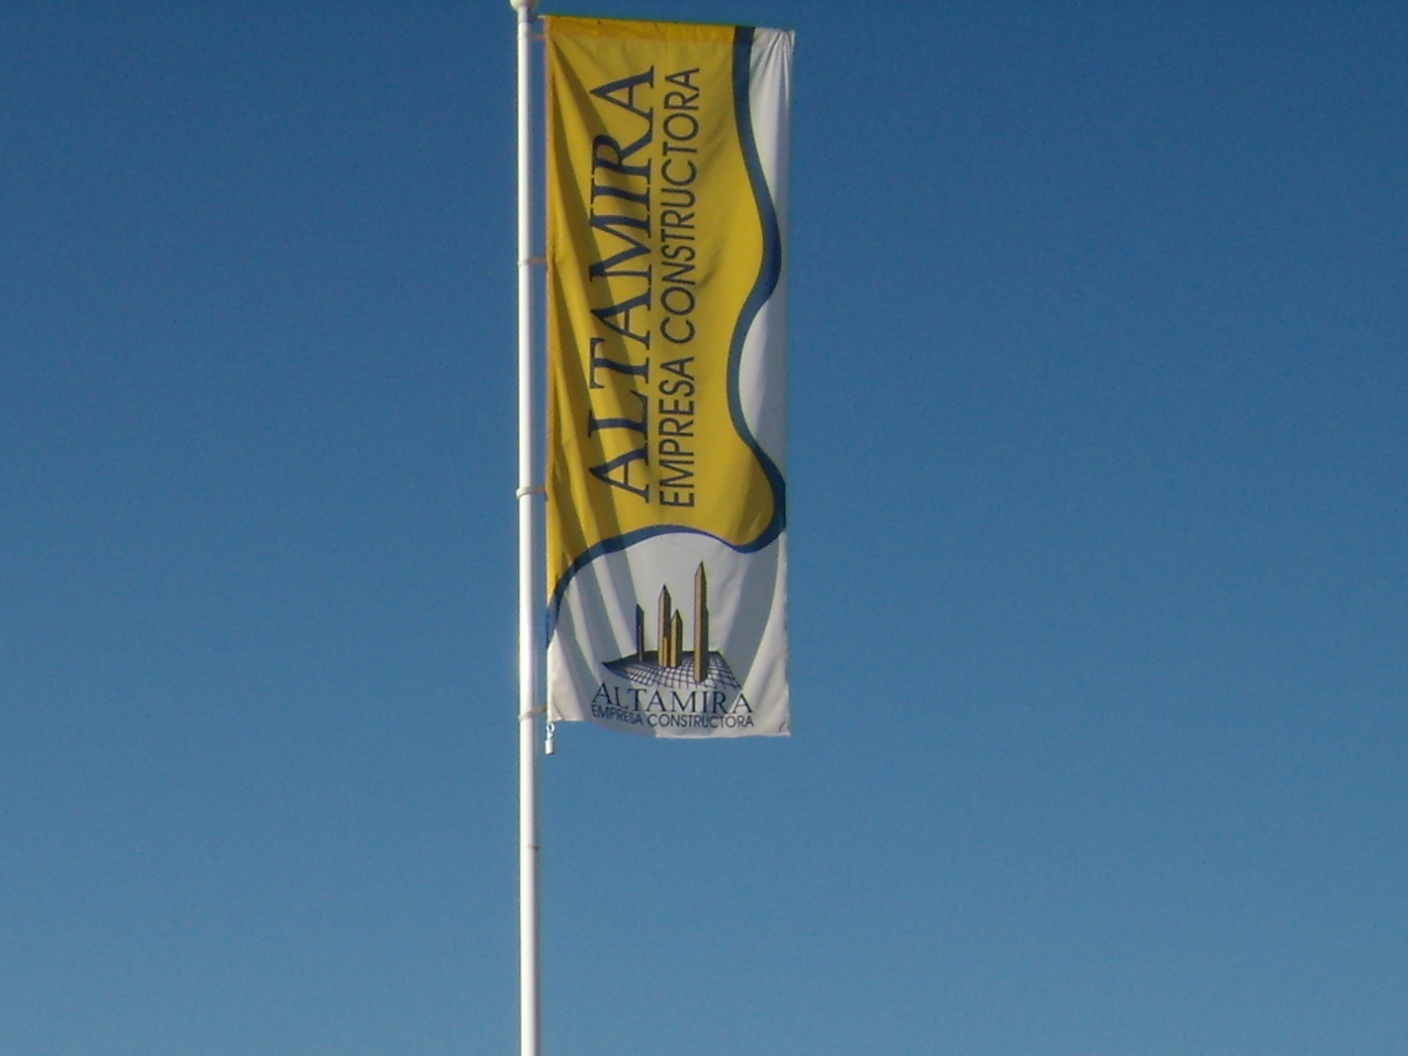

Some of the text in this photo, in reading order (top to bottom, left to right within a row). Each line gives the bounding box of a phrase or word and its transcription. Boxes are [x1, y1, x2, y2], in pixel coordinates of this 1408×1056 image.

[589, 65, 655, 503] ALTAMIRA
[659, 67, 700, 508] EMPRESA CONSTRUCTORA
[592, 682, 754, 714] ALTAMIRA
[592, 704, 755, 728] EMPRESA CONSTRUCTORA
